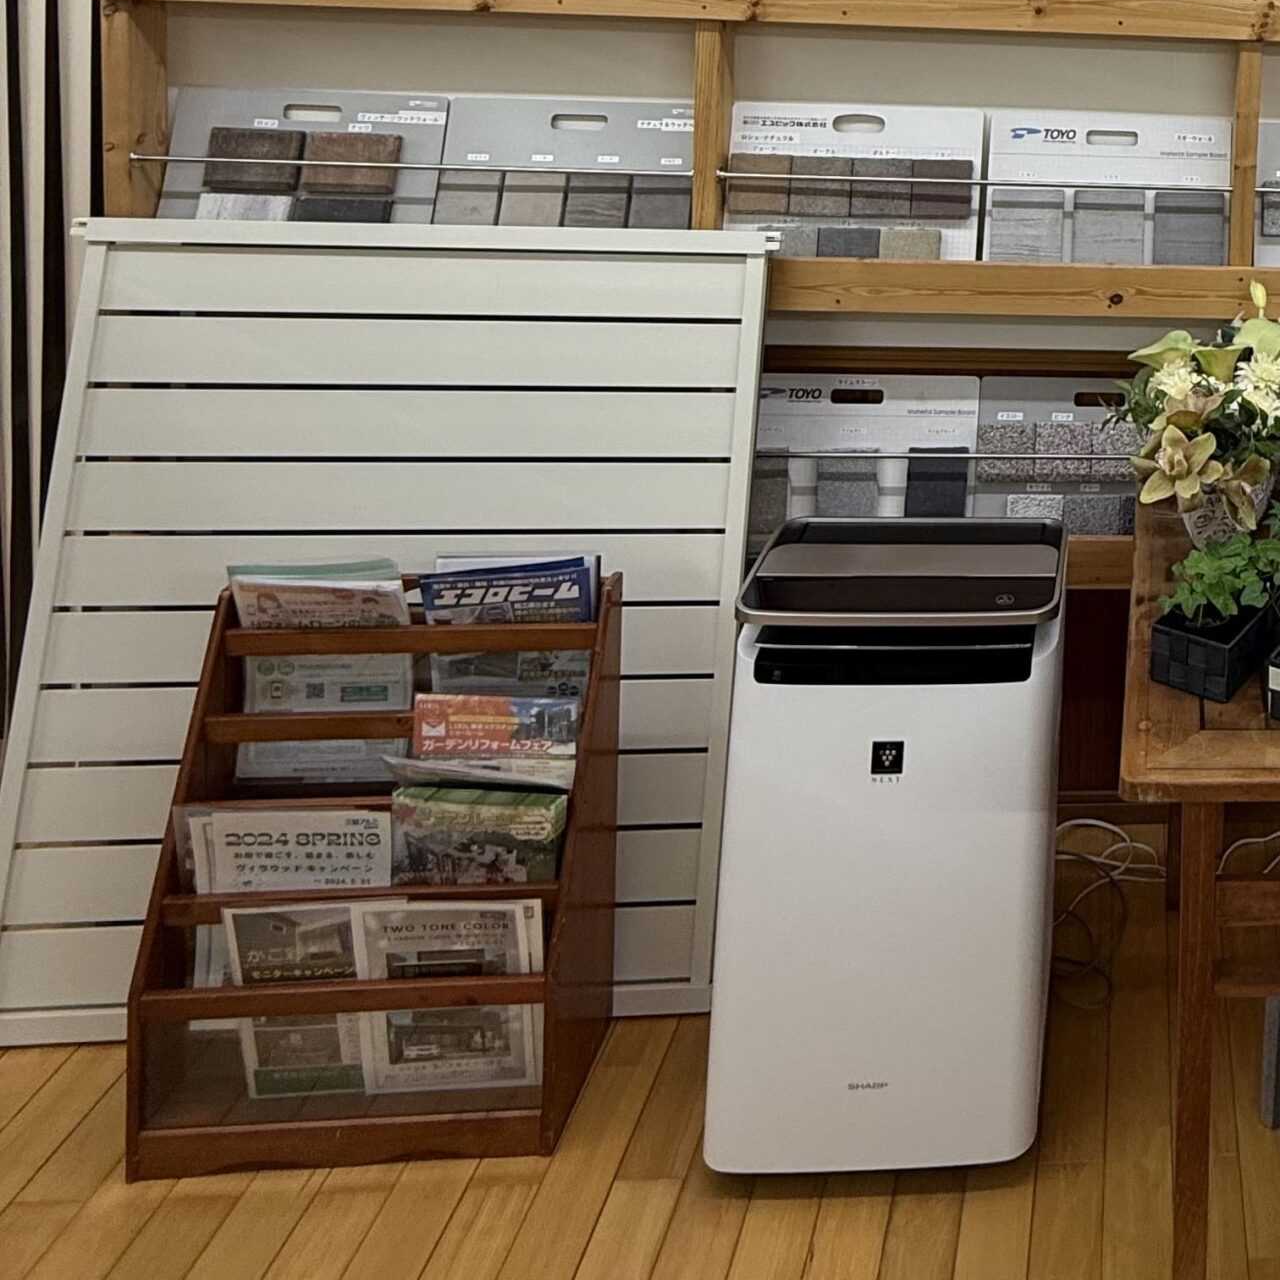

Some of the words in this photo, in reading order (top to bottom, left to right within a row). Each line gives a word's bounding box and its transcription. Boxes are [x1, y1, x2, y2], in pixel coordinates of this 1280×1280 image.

[1043, 128, 1077, 140] TOYO
[788, 388, 822, 399] TOYO
[433, 582, 580, 606] エコロビーム
[422, 738, 552, 752] ガーデンリフォームフェア
[225, 832, 290, 846] 2024
[295, 832, 382, 846] SPRING
[383, 923, 415, 933] TWO
[422, 923, 455, 932] TONE
[463, 921, 509, 930] COLOR
